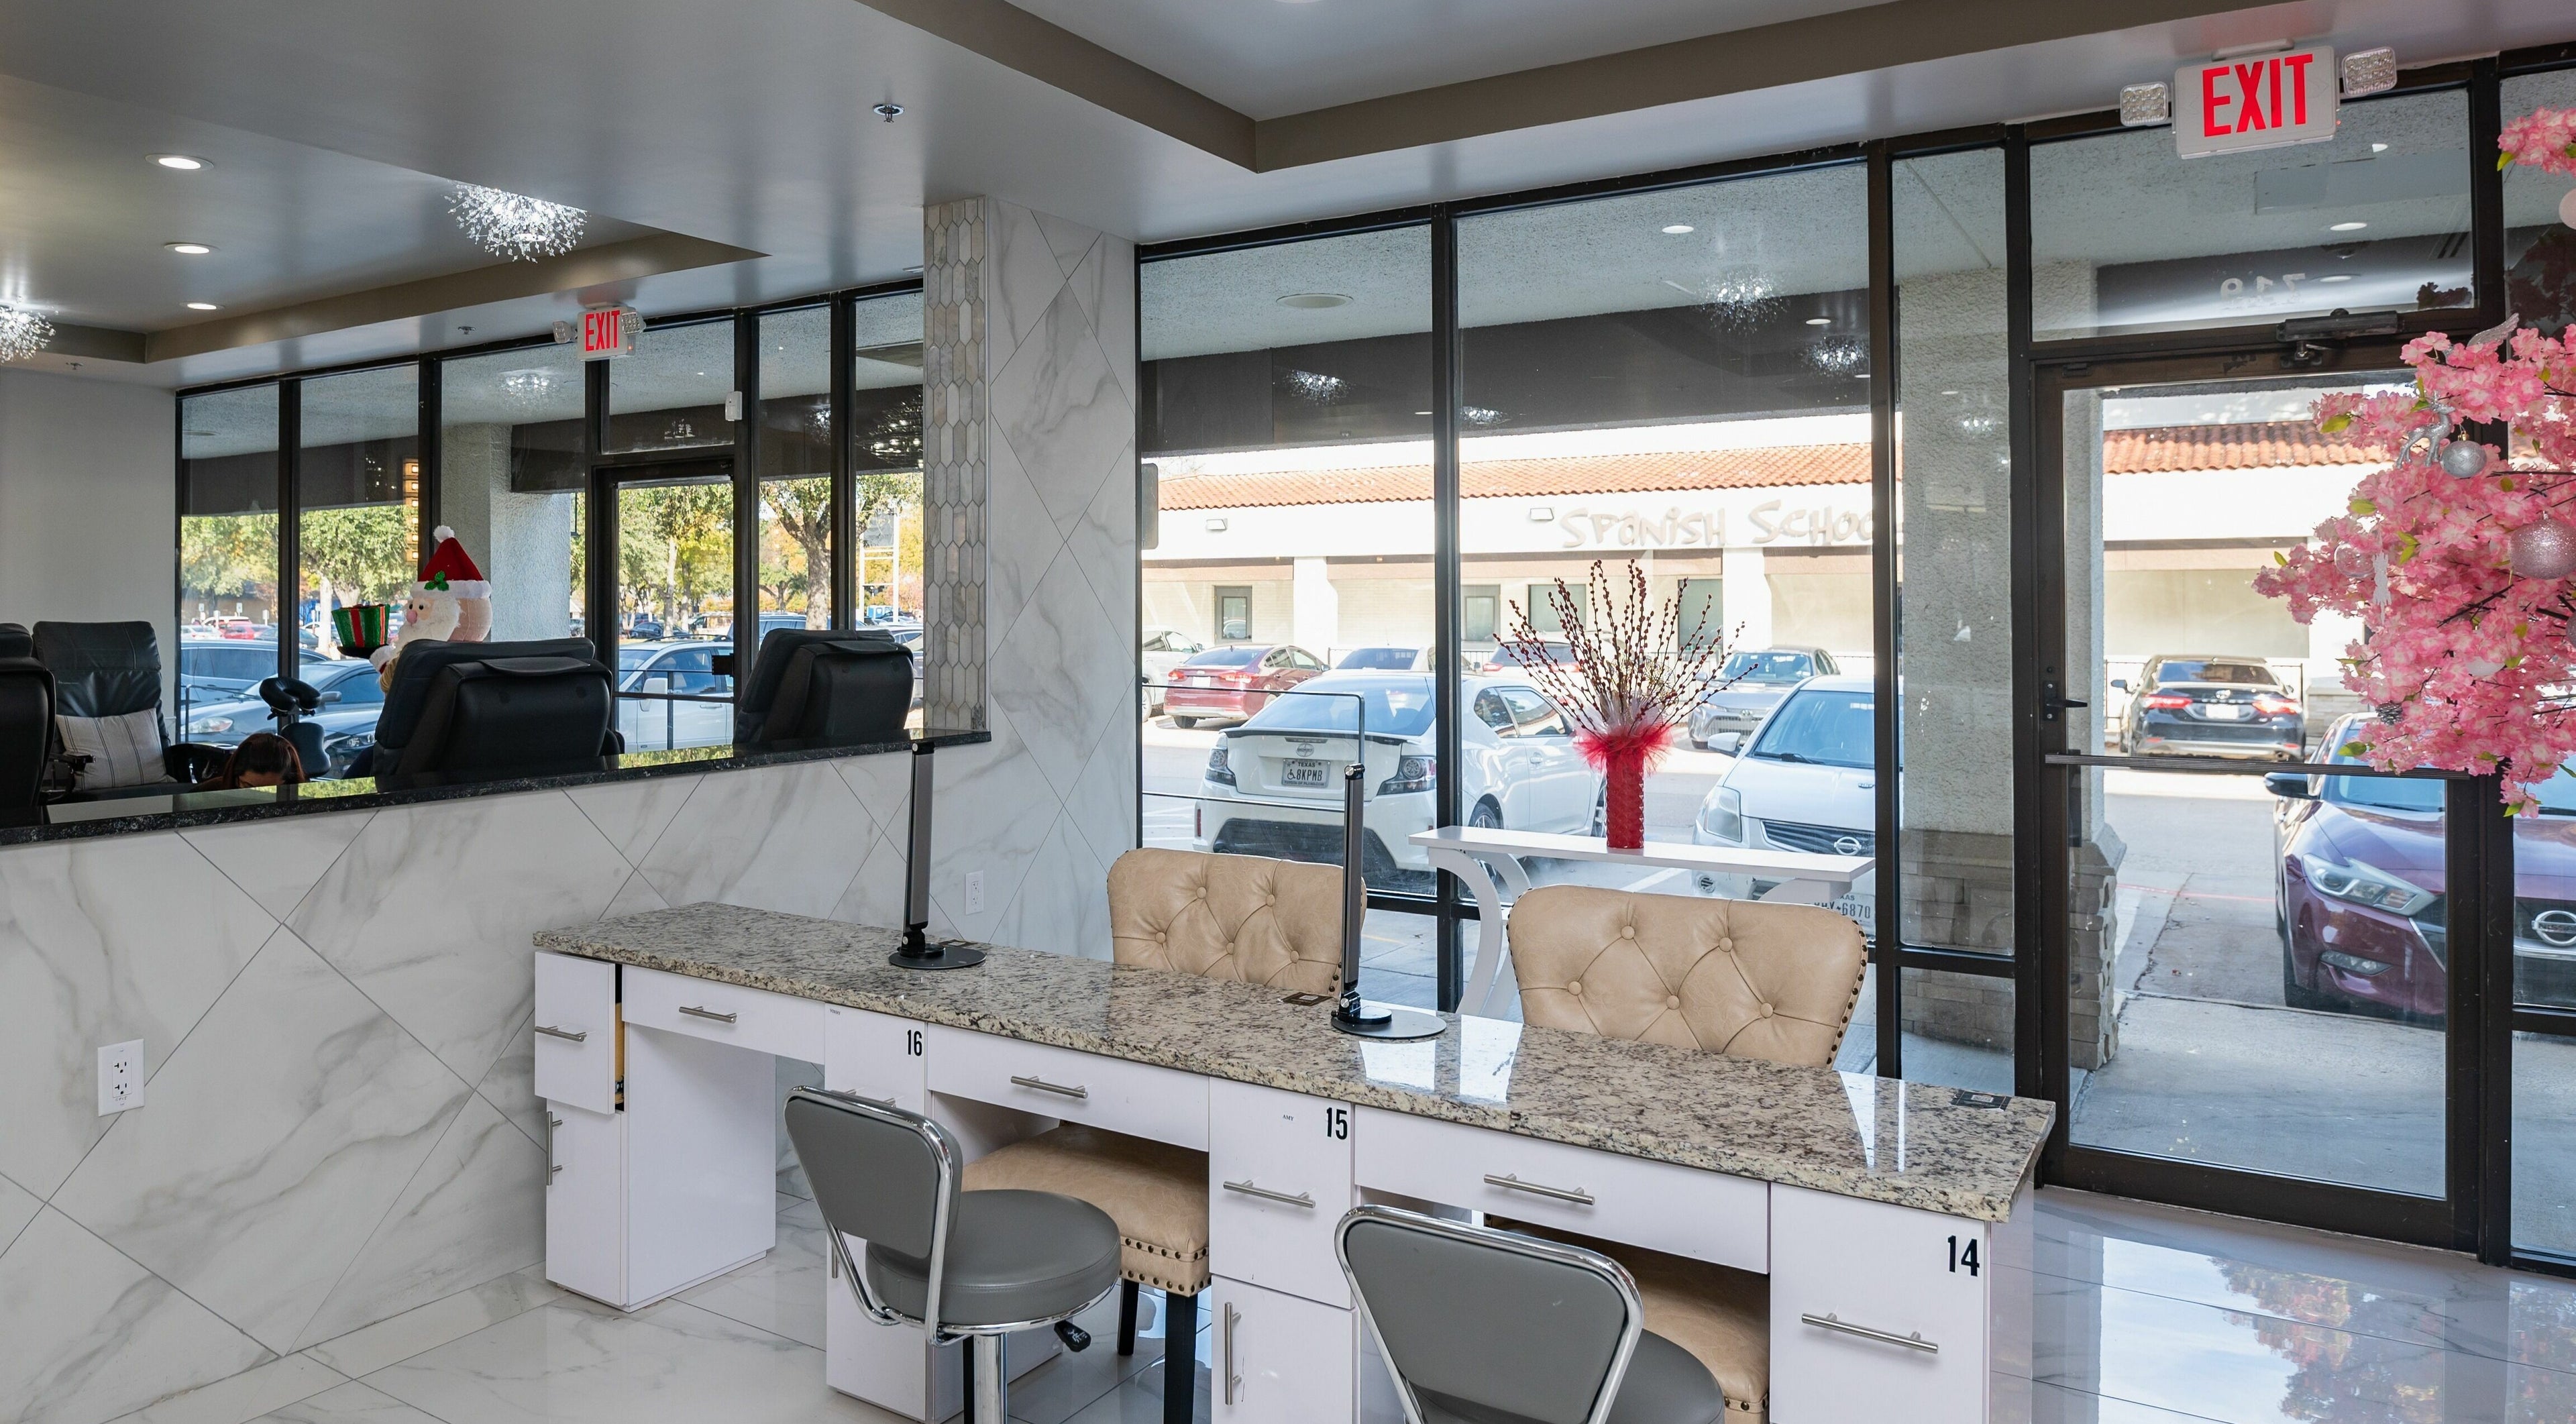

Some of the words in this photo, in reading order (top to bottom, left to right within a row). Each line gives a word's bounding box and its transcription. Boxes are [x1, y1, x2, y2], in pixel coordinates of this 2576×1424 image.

[2202, 54, 2313, 137] EXIT
[585, 310, 621, 351] EXIT
[1749, 499, 1874, 545] SCHOO
[908, 1030, 922, 1056] 16
[1327, 1107, 1348, 1140] 15
[1948, 1235, 1980, 1277] 14
